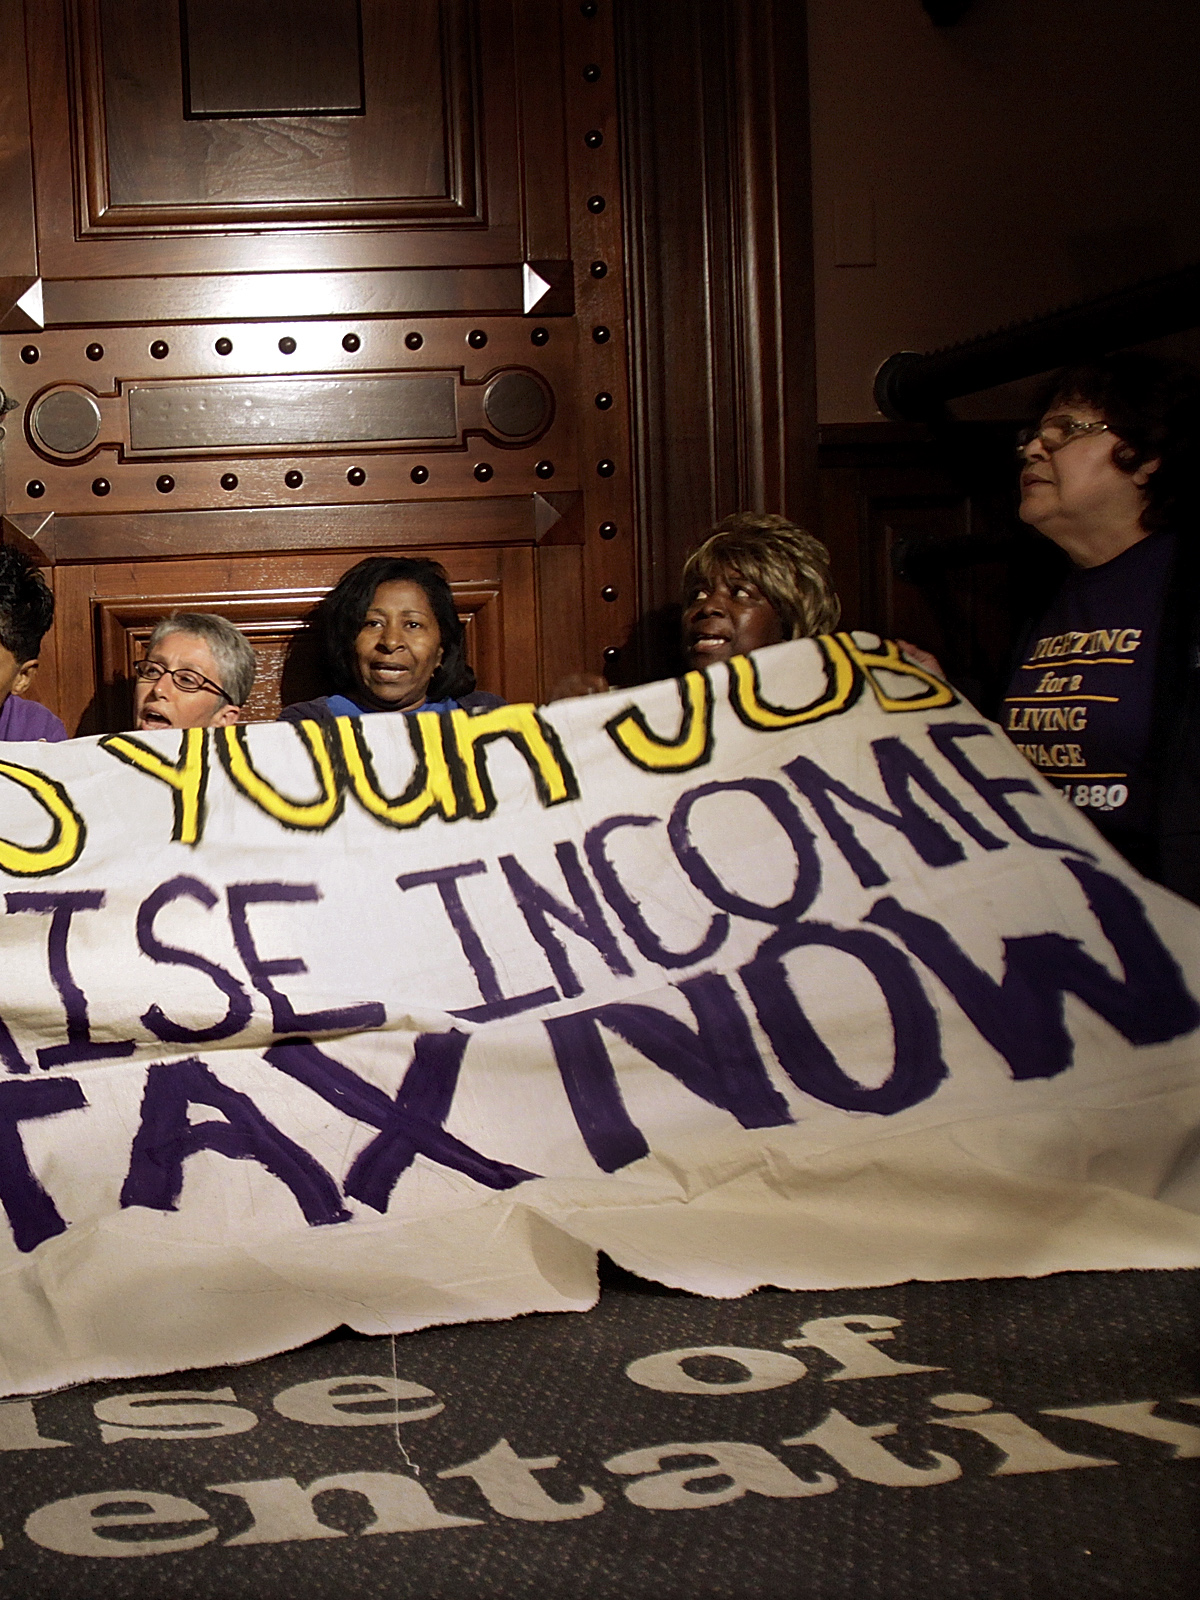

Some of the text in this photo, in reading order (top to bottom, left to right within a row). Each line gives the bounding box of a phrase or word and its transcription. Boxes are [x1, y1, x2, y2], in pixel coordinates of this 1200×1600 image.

[604, 631, 961, 774] JOB
[1007, 706, 1088, 731] LIVING
[1035, 671, 1083, 693] for a
[1073, 784, 1129, 808] 880
[396, 722, 1100, 1024] INCOME
[542, 856, 1200, 1175] NOW
[625, 1314, 949, 1396] of
